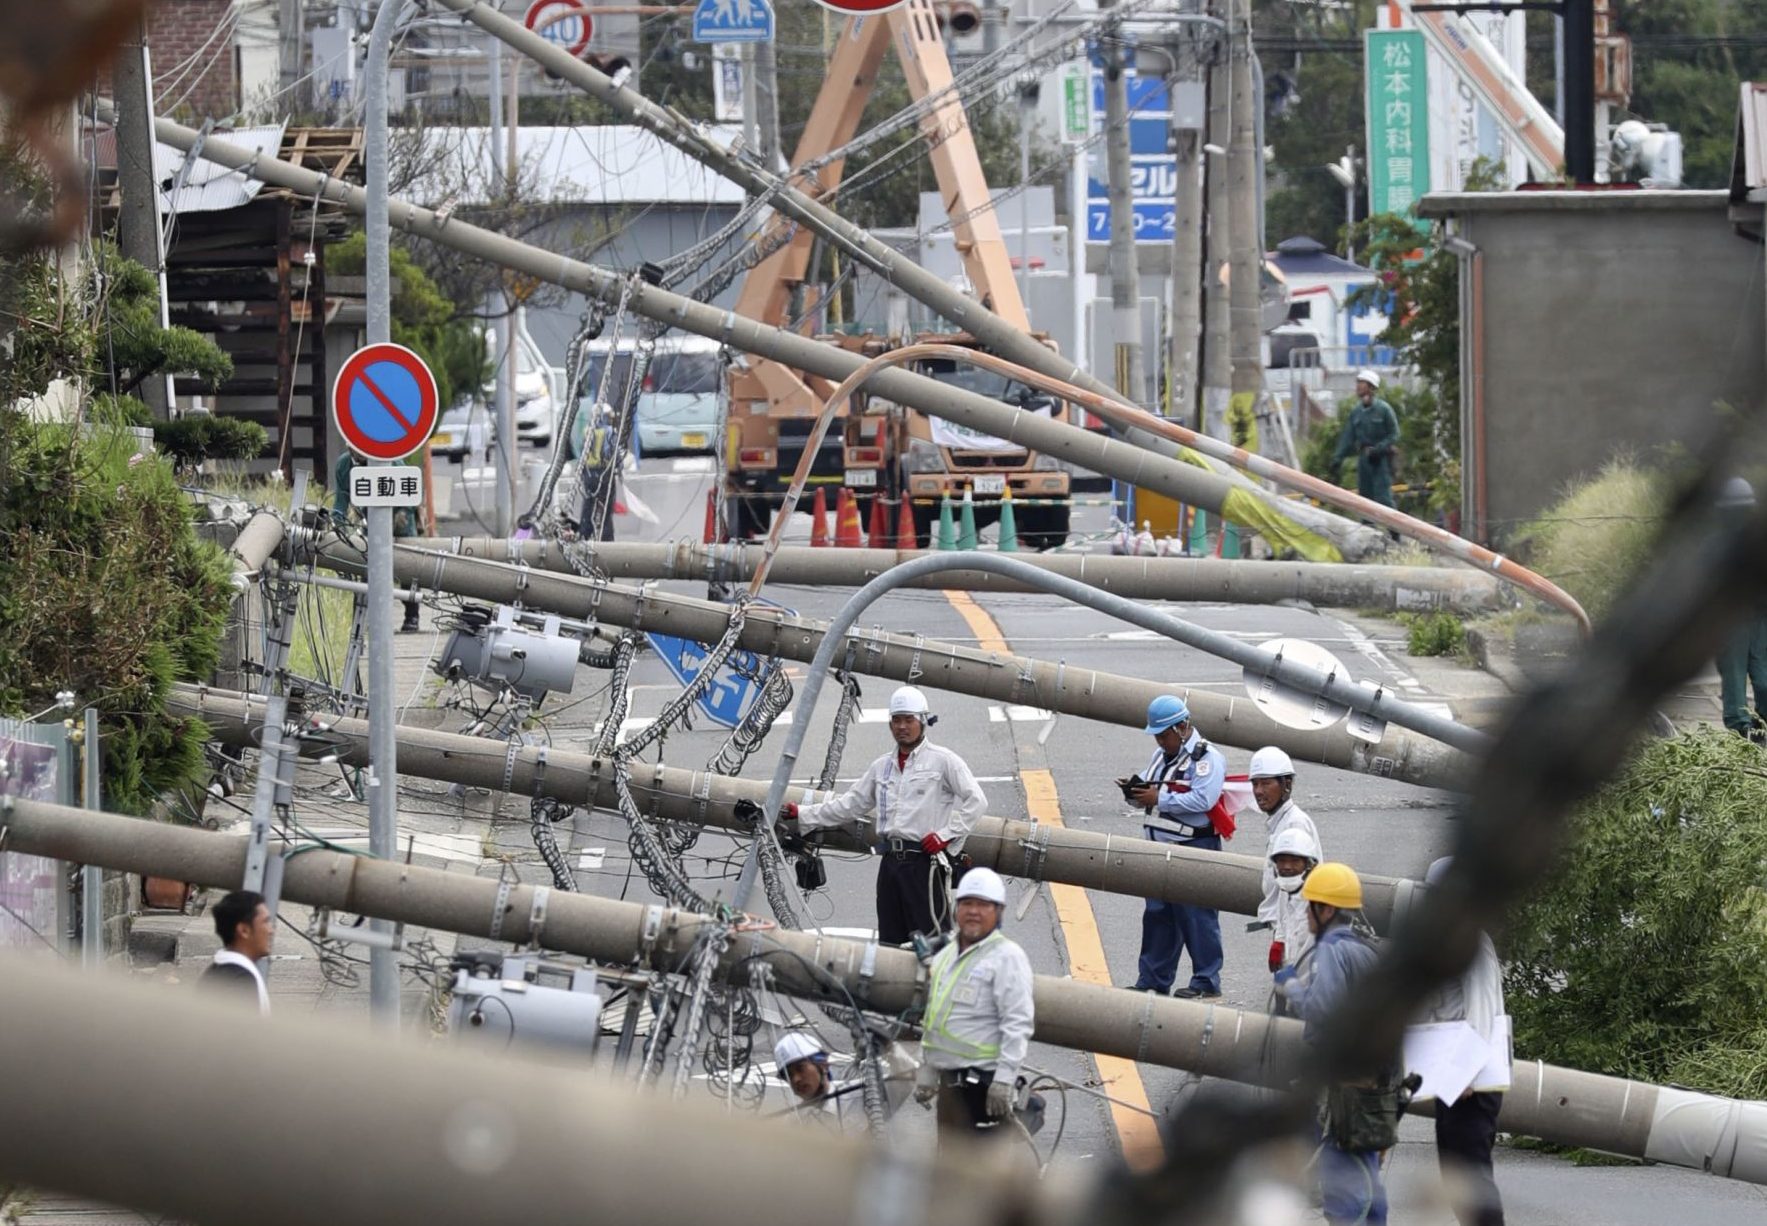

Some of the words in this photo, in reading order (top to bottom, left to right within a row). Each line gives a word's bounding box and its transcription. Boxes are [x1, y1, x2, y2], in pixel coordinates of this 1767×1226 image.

[1383, 41, 1414, 222] 松本内科胃腸
[355, 476, 418, 497] 自動車
